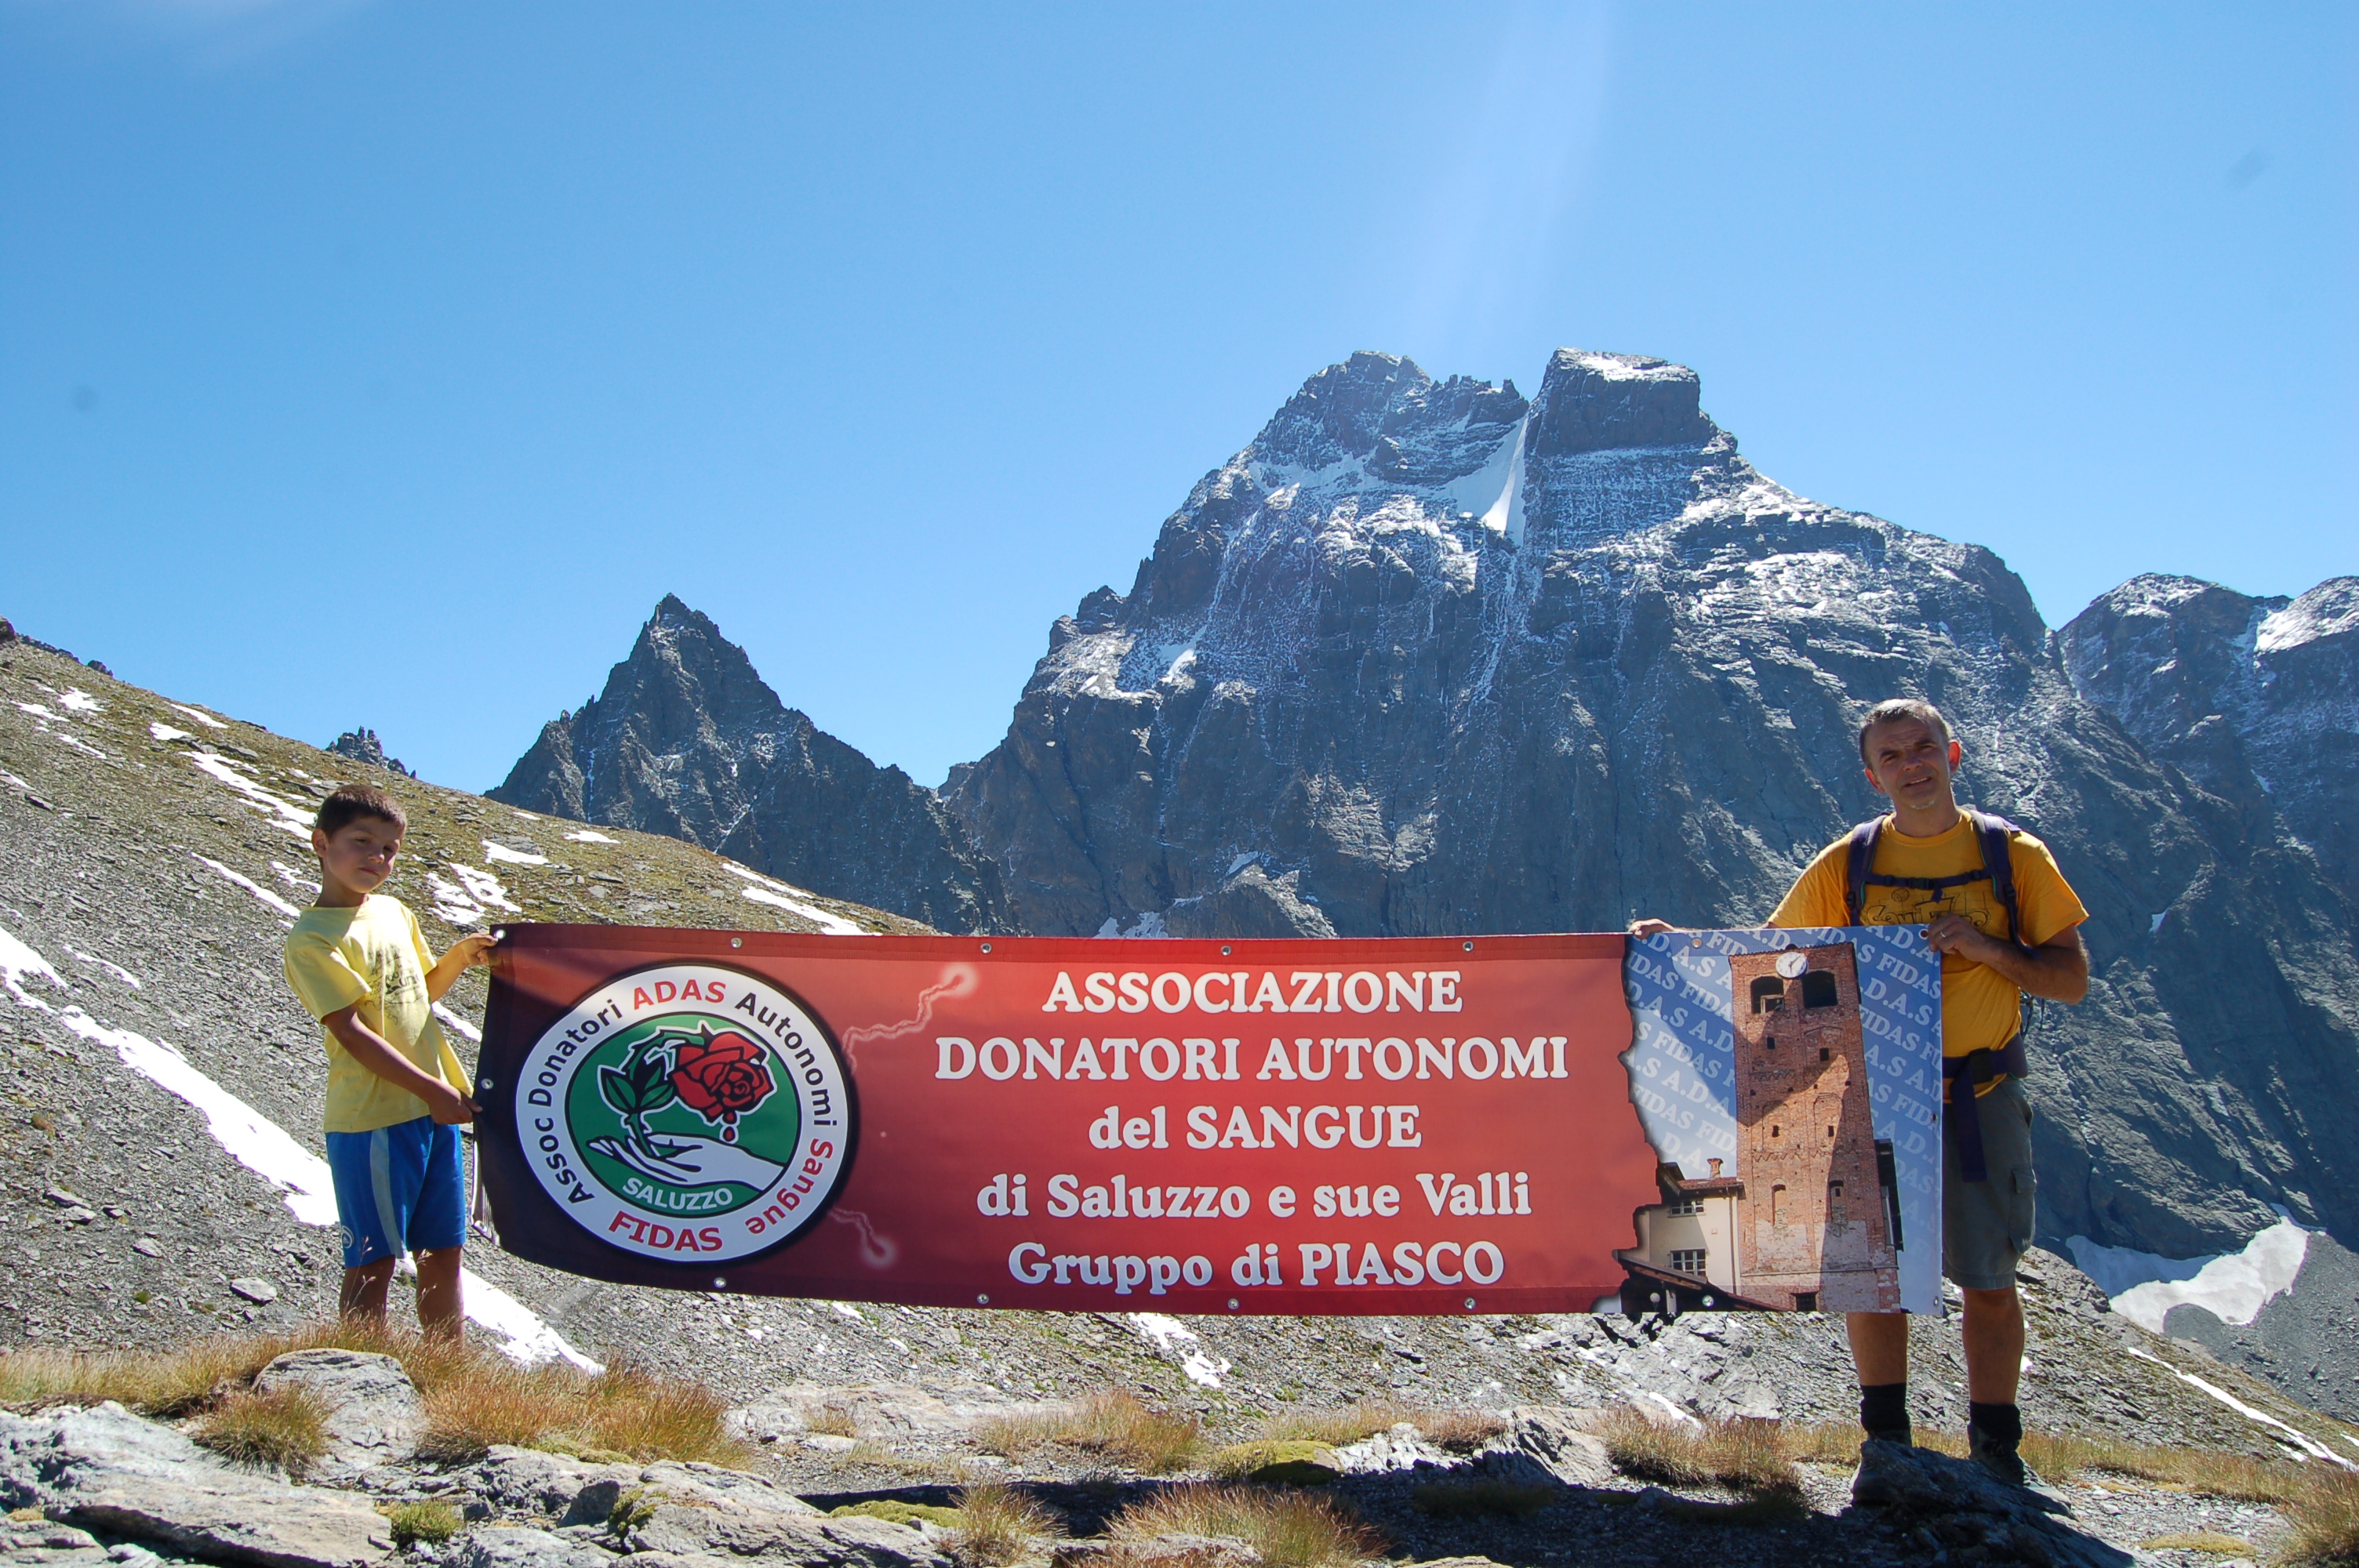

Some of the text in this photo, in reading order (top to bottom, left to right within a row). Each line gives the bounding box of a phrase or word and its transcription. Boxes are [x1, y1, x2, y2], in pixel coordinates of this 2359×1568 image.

[1041, 971, 1463, 1014] ASSOCIAZIONE
[1876, 953, 1941, 1000] FIDAS
[935, 1036, 1568, 1080] DONATORI AUTONOMI
[1652, 1030, 1722, 1079] FIDAS
[528, 978, 838, 1235] Assoc Donatori ADAS Autonomi Sangue
[1089, 1105, 1423, 1149] del SANGUE
[622, 1177, 732, 1211] SALUZZO
[976, 1171, 1532, 1218] di Saluzzo e sue Valli
[609, 1210, 723, 1253] FIDAS
[1009, 1240, 1505, 1294] Gruppo di PIASCO
